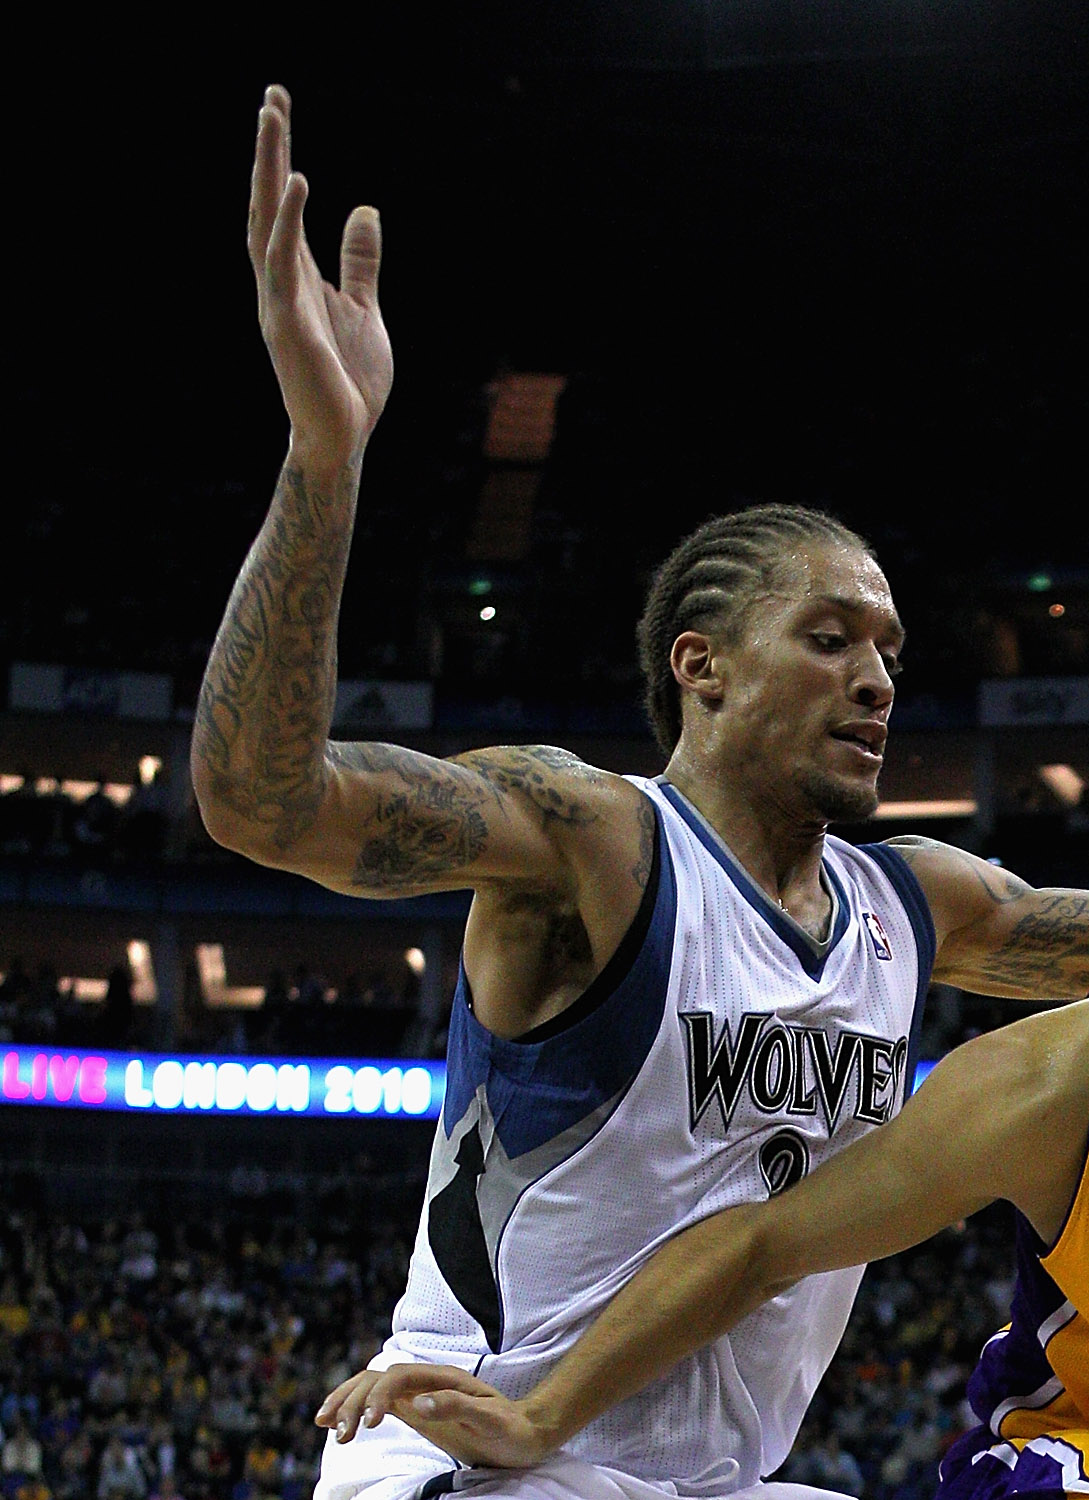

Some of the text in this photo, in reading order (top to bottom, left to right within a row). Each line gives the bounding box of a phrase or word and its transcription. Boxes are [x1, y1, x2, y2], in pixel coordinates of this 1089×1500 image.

[3, 1051, 432, 1115] LIVE LONDON 2010
